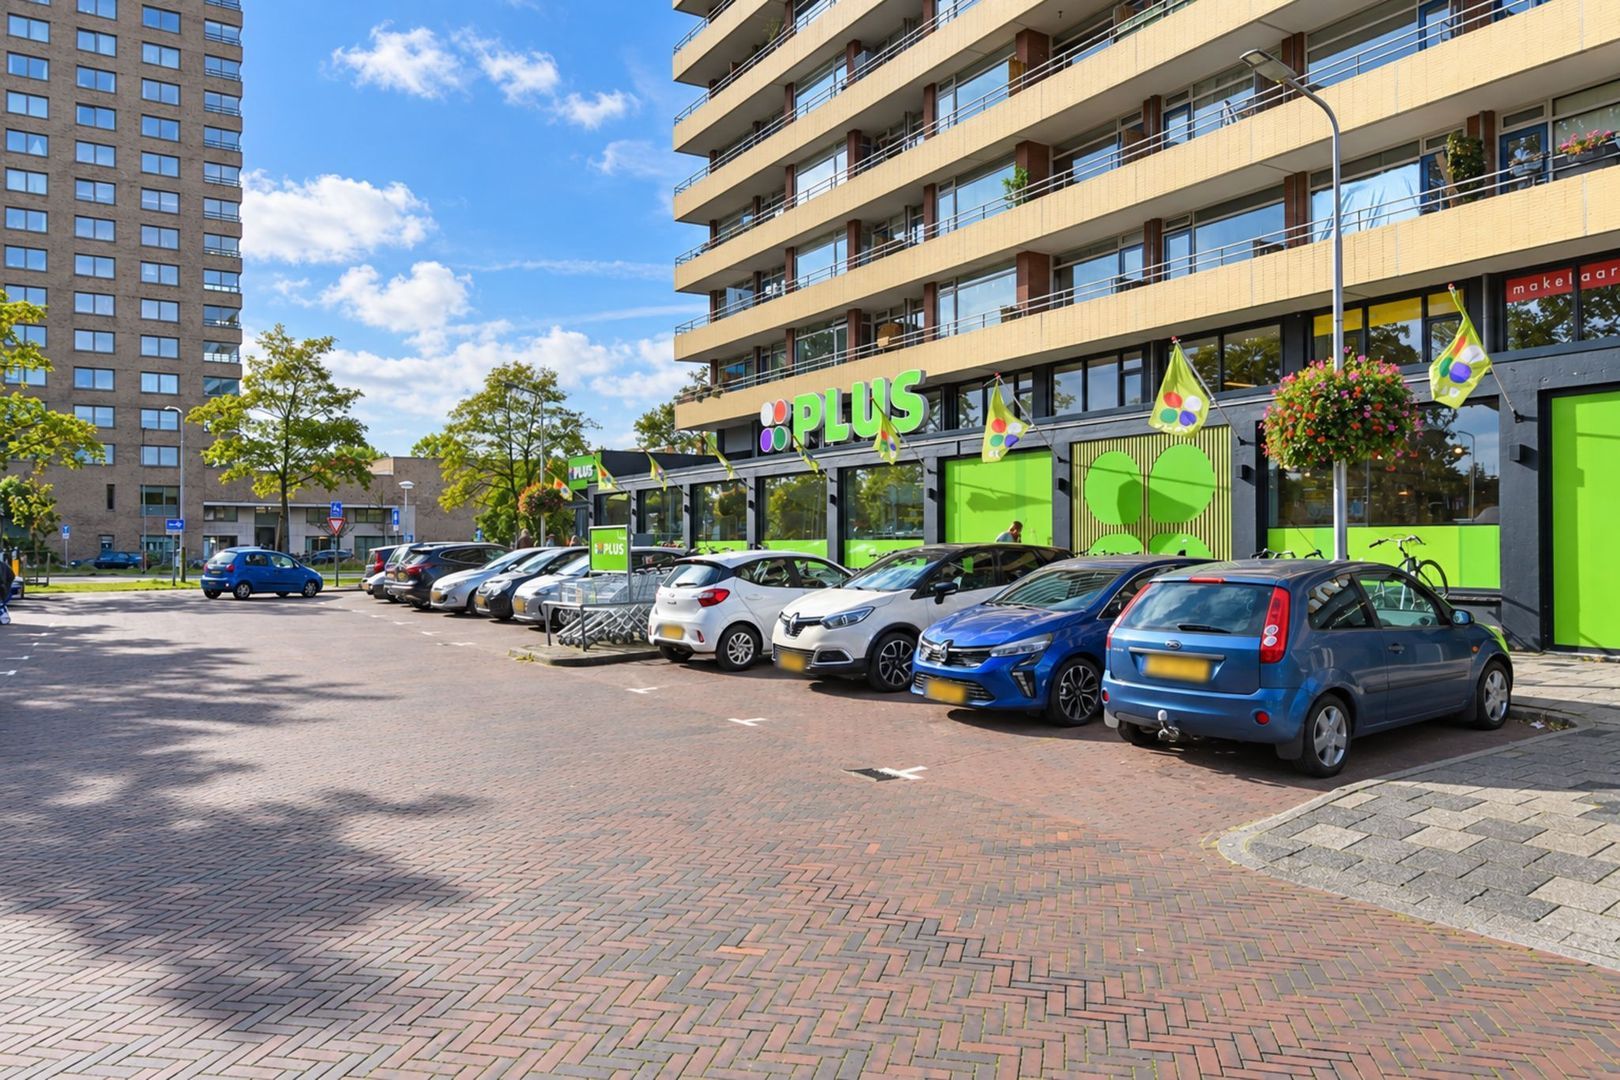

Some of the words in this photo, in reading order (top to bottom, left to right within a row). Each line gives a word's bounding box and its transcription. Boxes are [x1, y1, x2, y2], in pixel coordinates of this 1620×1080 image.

[1513, 267, 1618, 294] makelaar
[793, 369, 927, 448] PLUS
[573, 464, 593, 480] PLUS
[603, 543, 625, 555] PLUS
